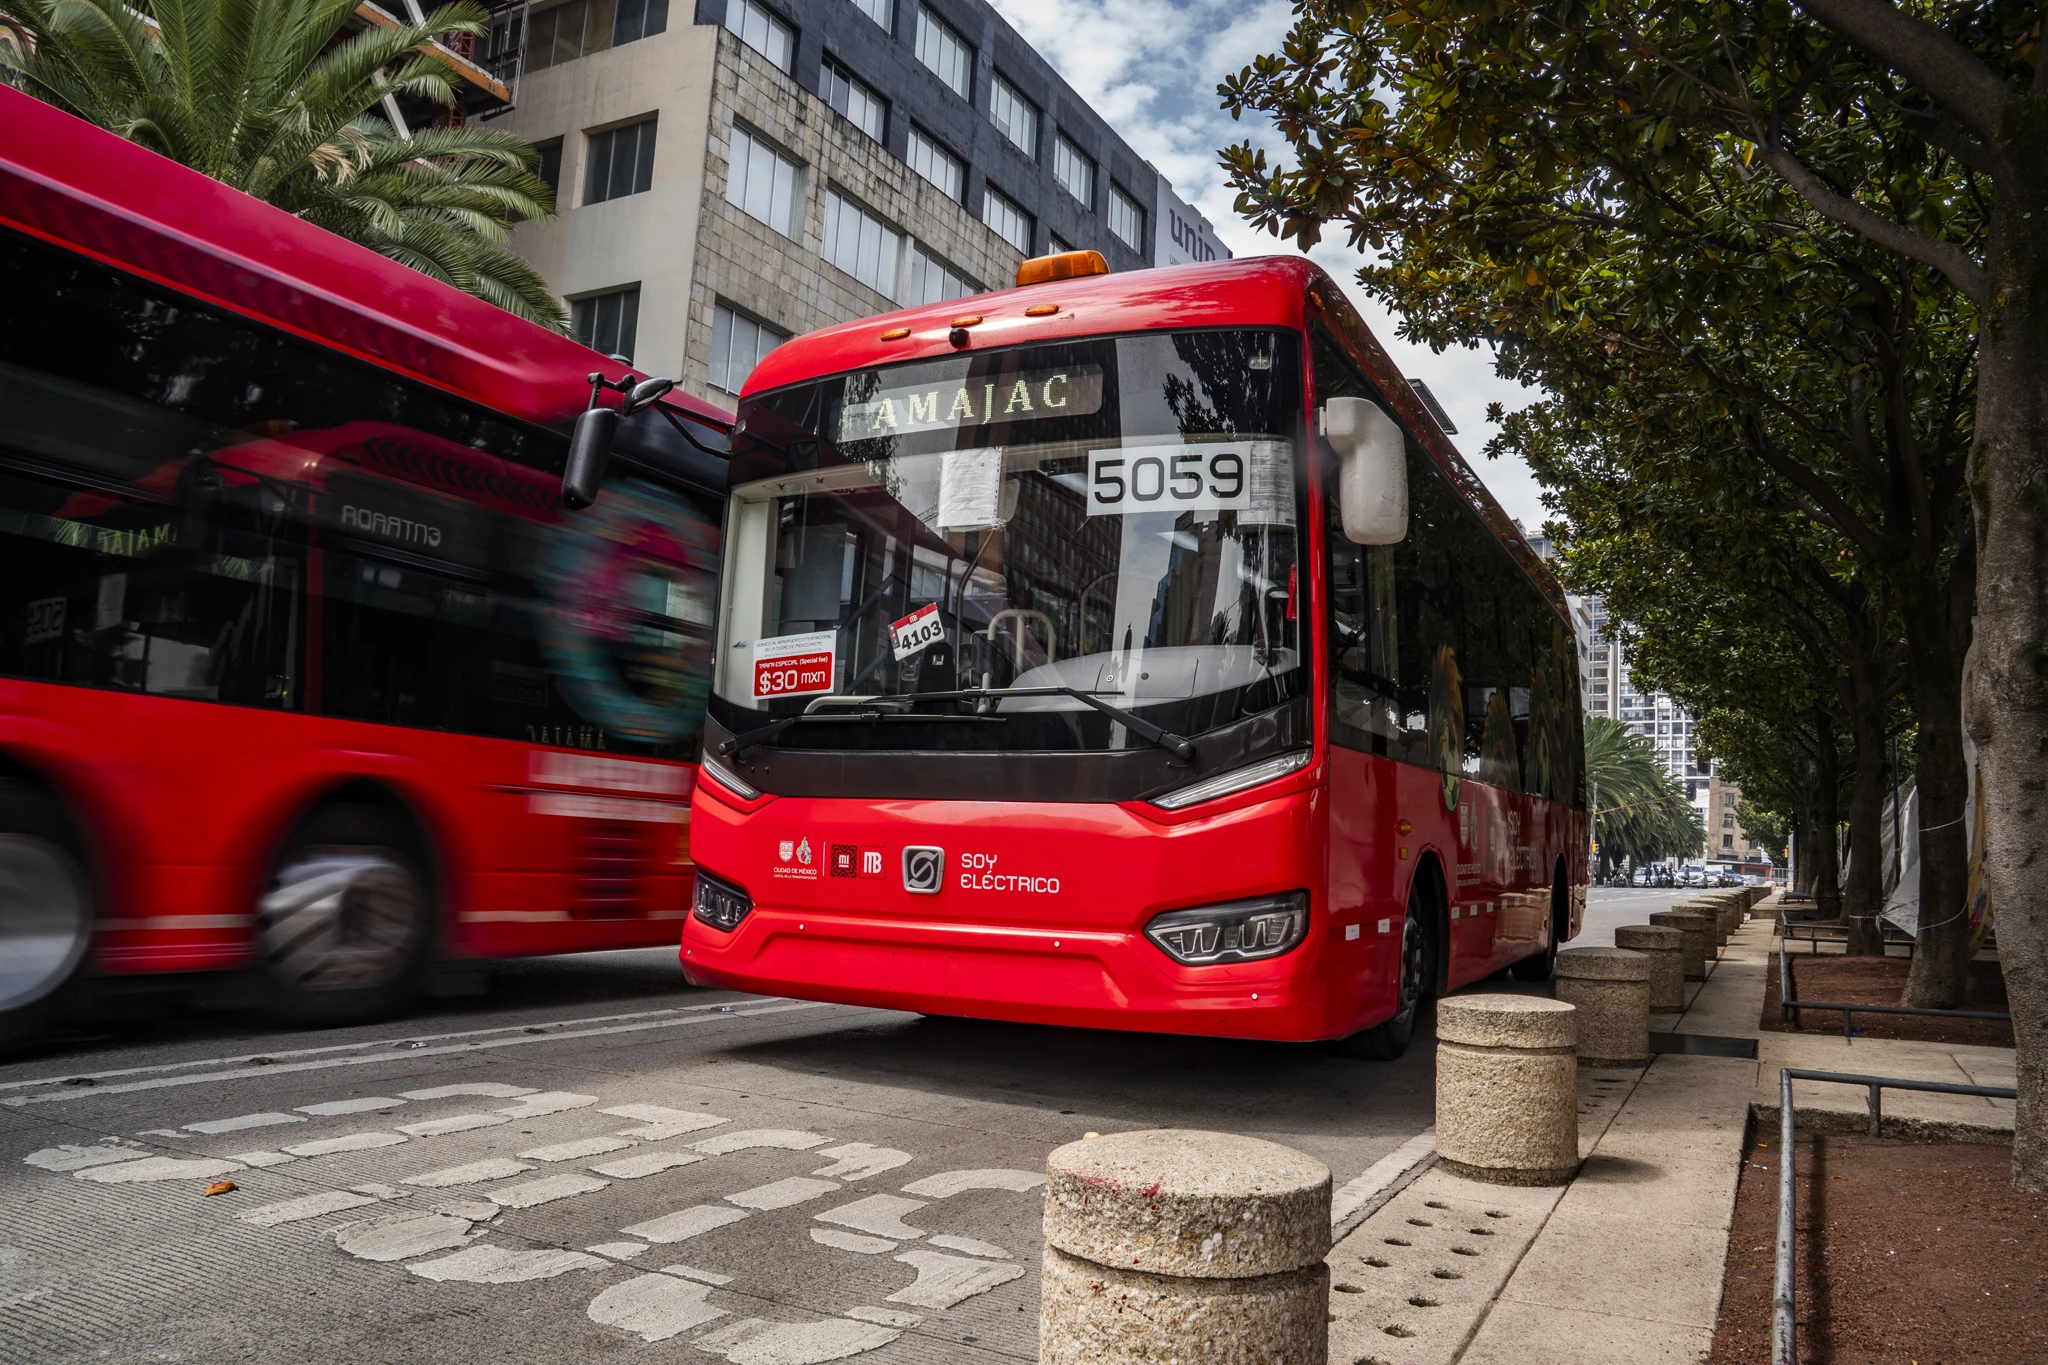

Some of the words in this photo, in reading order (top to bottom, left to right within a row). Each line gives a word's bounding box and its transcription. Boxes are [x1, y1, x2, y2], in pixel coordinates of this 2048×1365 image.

[872, 374, 1067, 430] AMAJAC
[1094, 453, 1244, 504] 5059
[902, 620, 942, 650] 4103
[759, 669, 798, 694] $30
[773, 866, 791, 874] CIUDAD
[798, 867, 817, 875] MÉXICO
[863, 851, 882, 874] MB
[961, 853, 998, 869] SOY
[960, 869, 1060, 894] ELÉCTRICO
